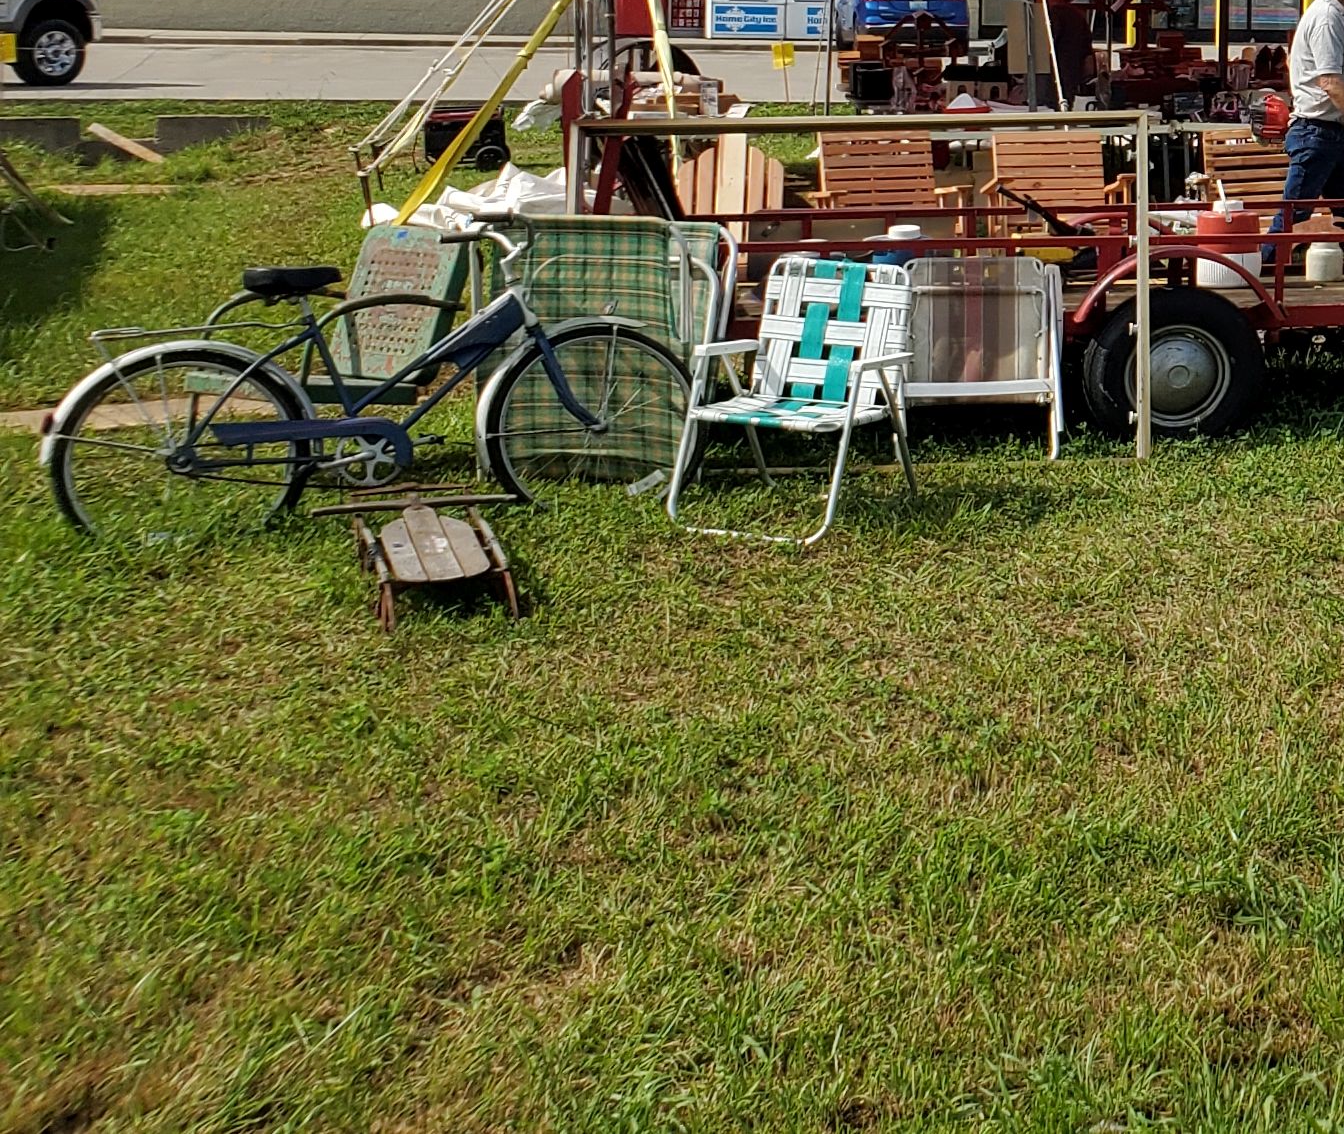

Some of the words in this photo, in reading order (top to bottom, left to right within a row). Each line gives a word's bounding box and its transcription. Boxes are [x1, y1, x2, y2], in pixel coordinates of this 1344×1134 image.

[715, 15, 743, 23] Home
[744, 15, 761, 24] City
[763, 15, 777, 23] Ice
